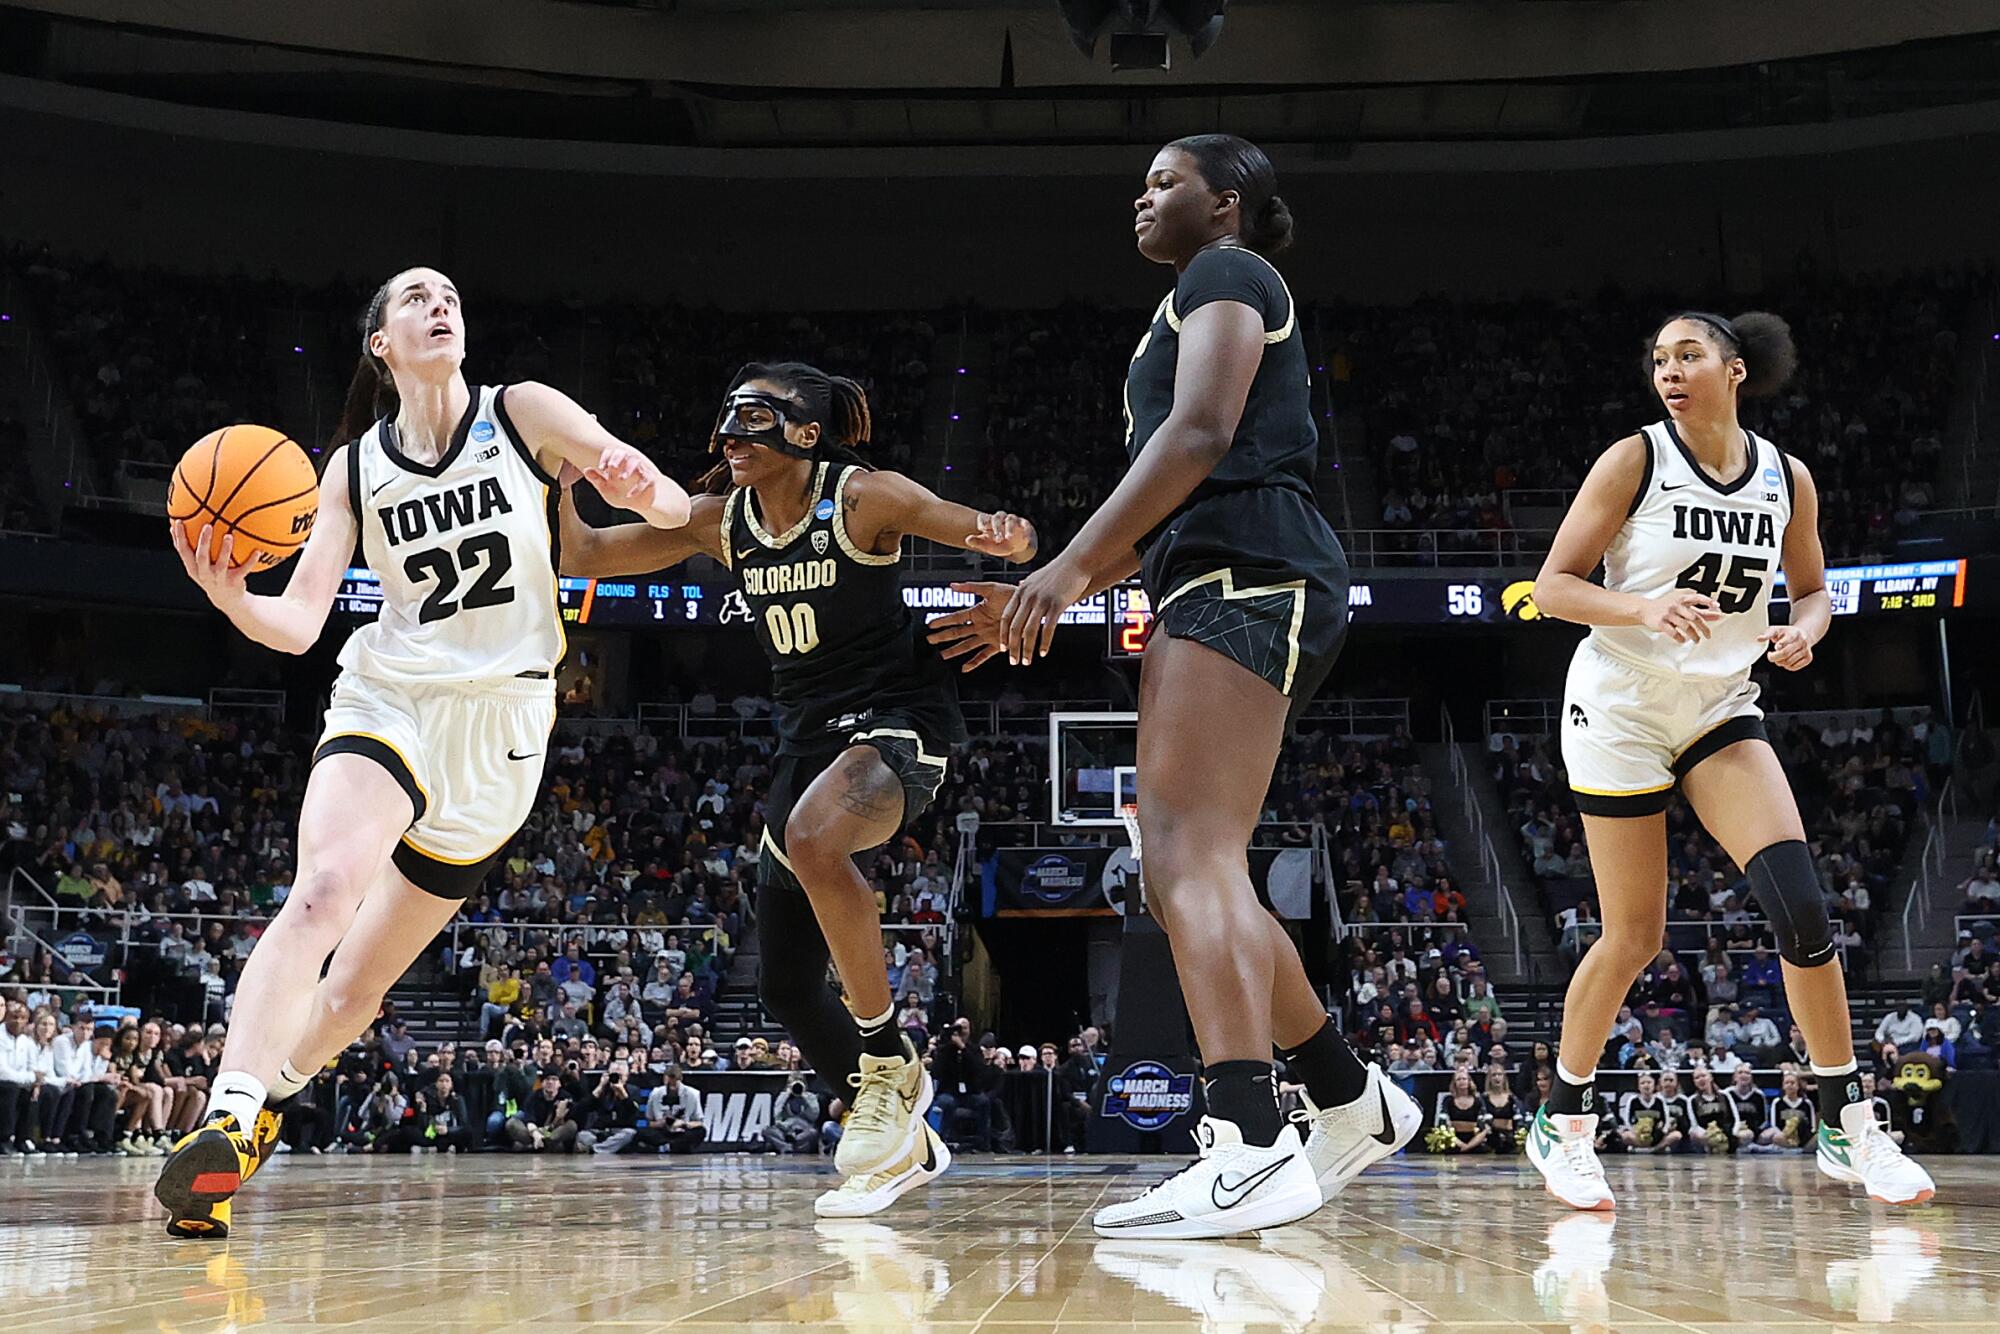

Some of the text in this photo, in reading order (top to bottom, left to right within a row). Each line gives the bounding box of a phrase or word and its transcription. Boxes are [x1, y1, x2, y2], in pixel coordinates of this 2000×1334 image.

[378, 477, 512, 546] IOWA
[1673, 505, 1775, 548] IOWA
[404, 531, 515, 625] 22
[596, 584, 703, 599] BONUS FLS TOL
[743, 559, 836, 595] COLORADO
[1675, 552, 1768, 614] 45
[1831, 581, 1850, 595] 40
[653, 600, 698, 620] 1 3
[1448, 585, 1482, 615] 56
[1912, 594, 1936, 608] 3RD
[765, 603, 820, 654] 00
[1123, 1079, 1169, 1093] MARCH
[1128, 1093, 1191, 1108] MADNESS
